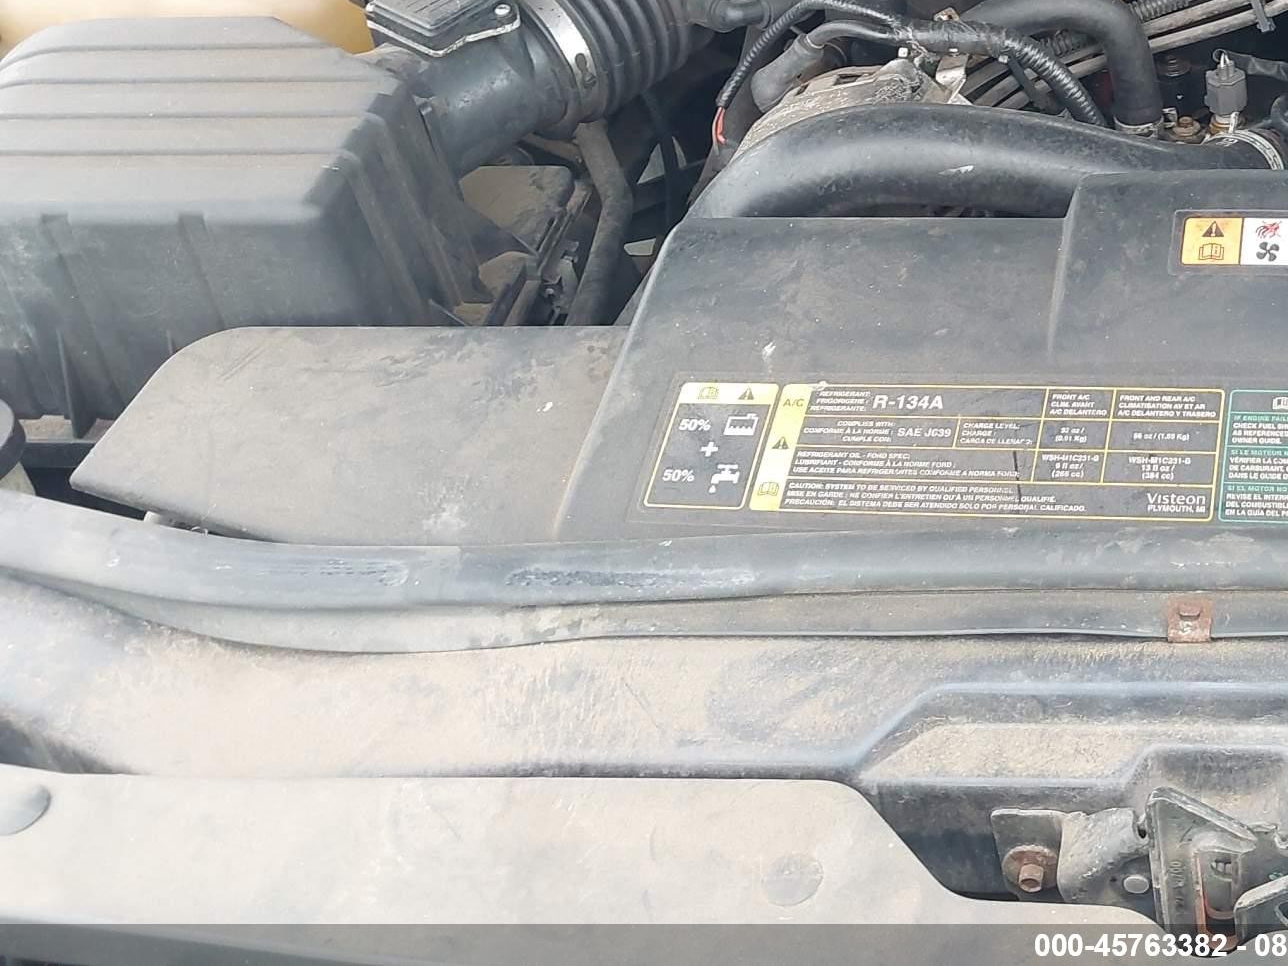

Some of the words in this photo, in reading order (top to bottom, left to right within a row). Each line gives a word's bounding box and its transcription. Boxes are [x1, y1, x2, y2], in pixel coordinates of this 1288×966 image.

[783, 399, 804, 407] A/C
[872, 395, 943, 409] R-134A
[679, 419, 712, 431] 50%
[897, 427, 922, 437] SAE
[662, 469, 695, 483] 50%
[1146, 492, 1206, 505] Visteon
[1147, 505, 1194, 513] PLYMOUTH,
